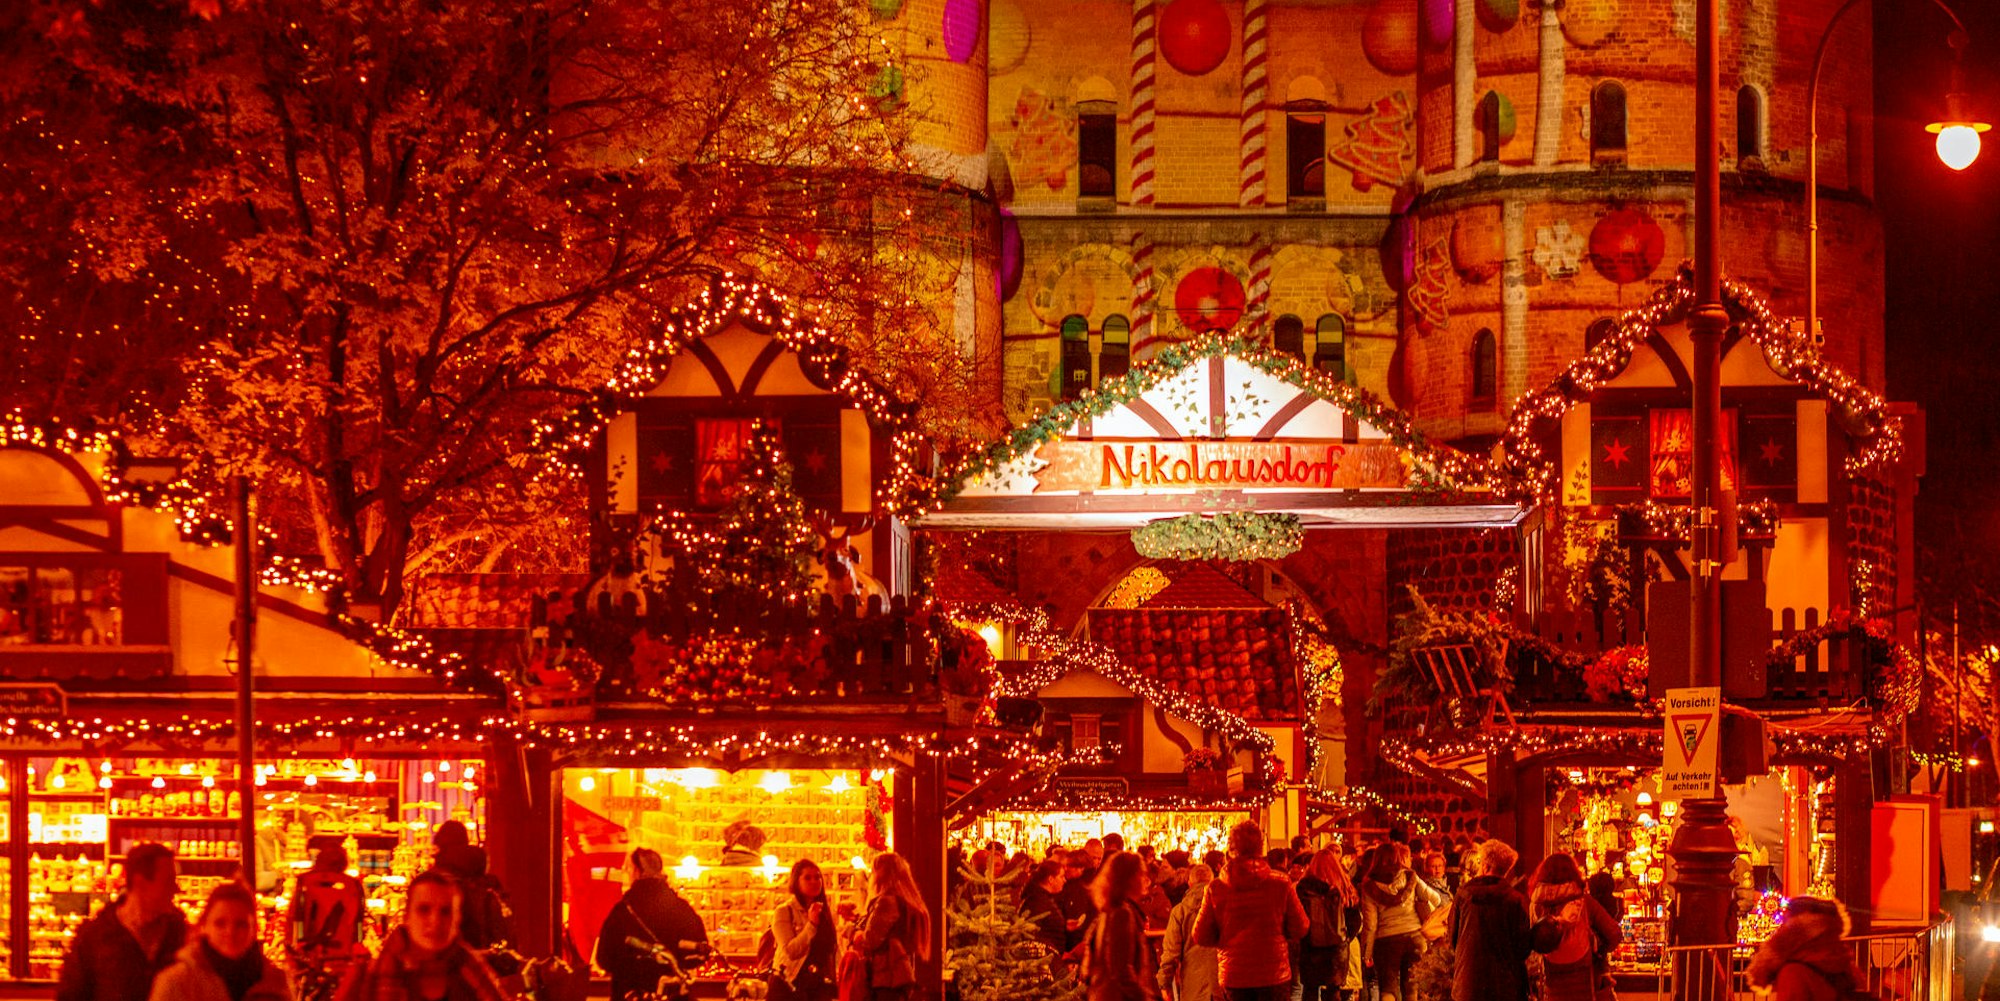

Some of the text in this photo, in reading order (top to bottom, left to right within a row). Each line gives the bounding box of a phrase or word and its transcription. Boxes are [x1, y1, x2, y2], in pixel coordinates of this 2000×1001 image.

[1100, 445, 1345, 488] Nikolausdorf
[1665, 771, 1711, 781] Auf Verkehr
